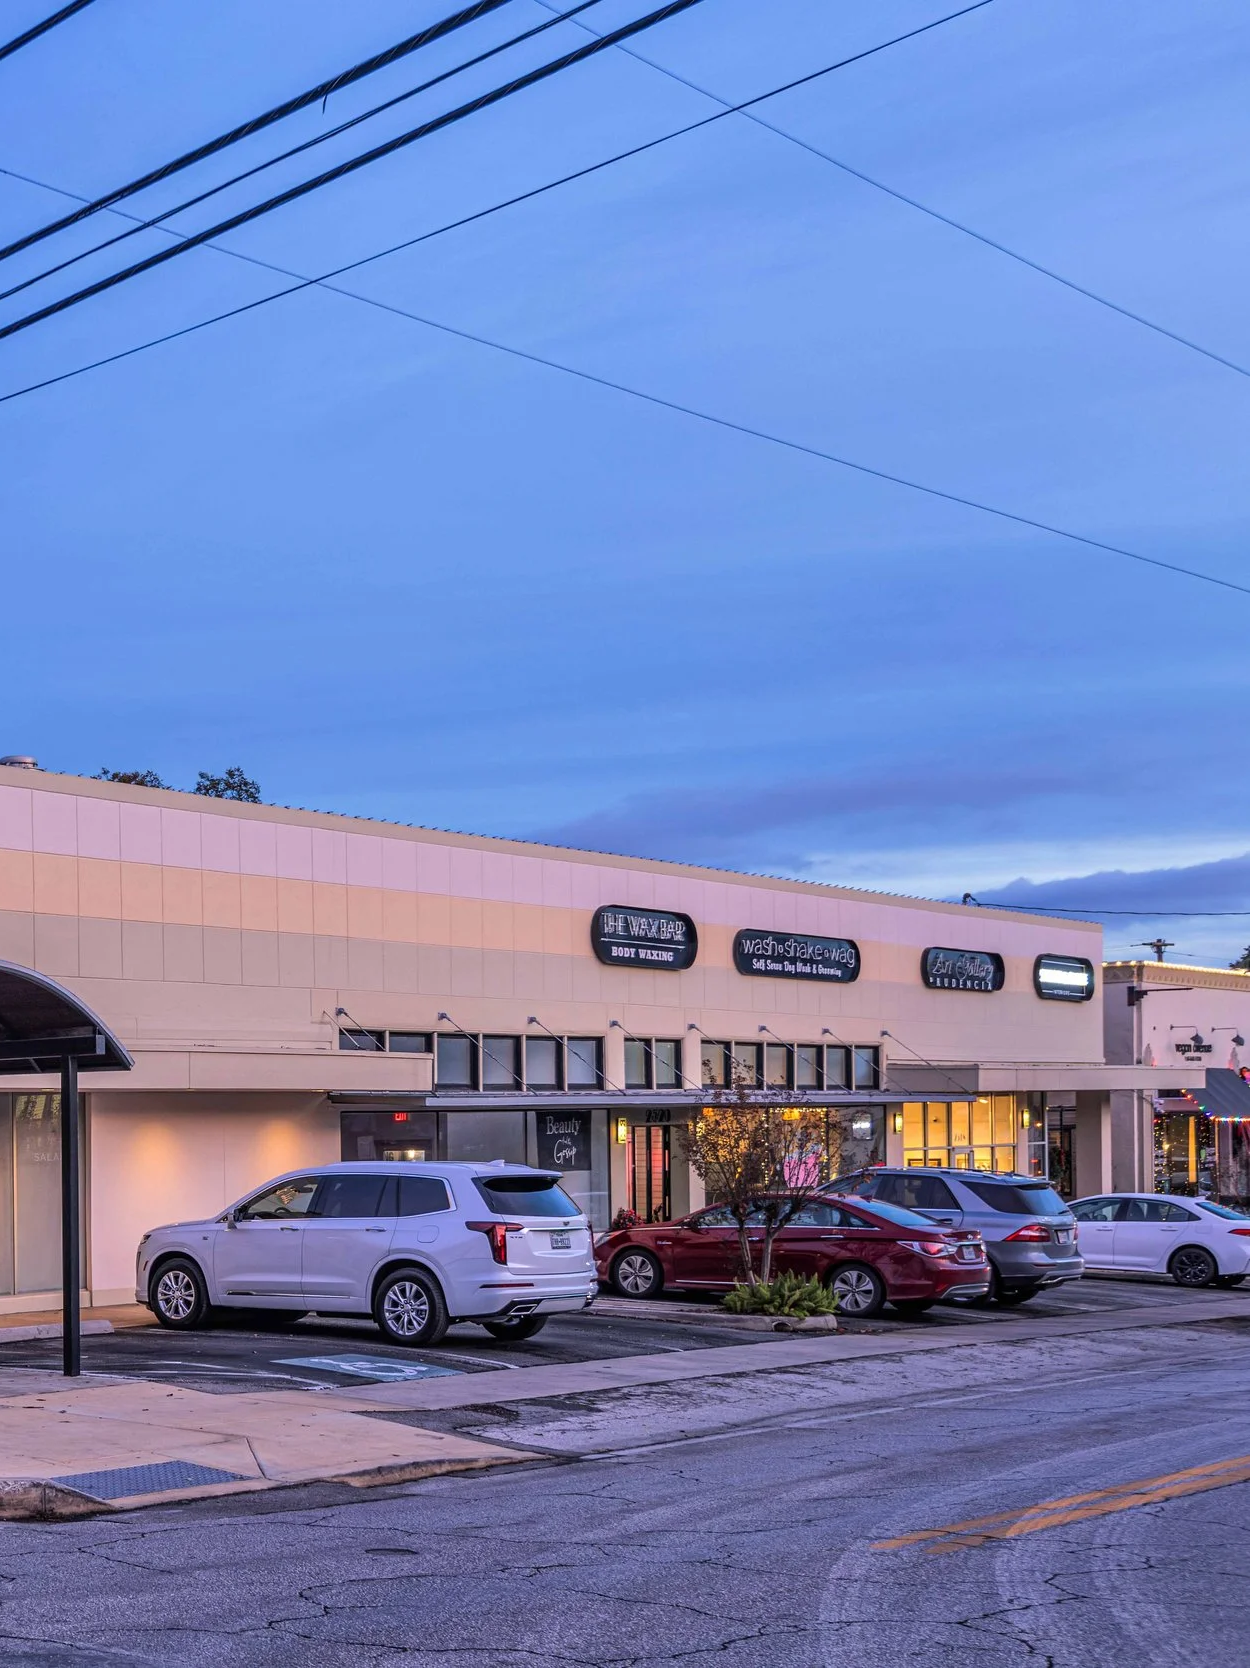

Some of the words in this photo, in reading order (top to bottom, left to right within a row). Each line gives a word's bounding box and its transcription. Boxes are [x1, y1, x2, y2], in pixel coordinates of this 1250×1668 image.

[601, 912, 628, 935] THE
[627, 915, 659, 938] WAX
[659, 919, 686, 941] BAR
[611, 946, 636, 958] BODY
[638, 948, 674, 962] WAXING
[752, 958, 765, 971] Self
[783, 961, 795, 974] Dog
[929, 976, 992, 991] PRUDENCIA
[546, 1115, 582, 1136] Beauty
[33, 1152, 62, 1162] SALA
